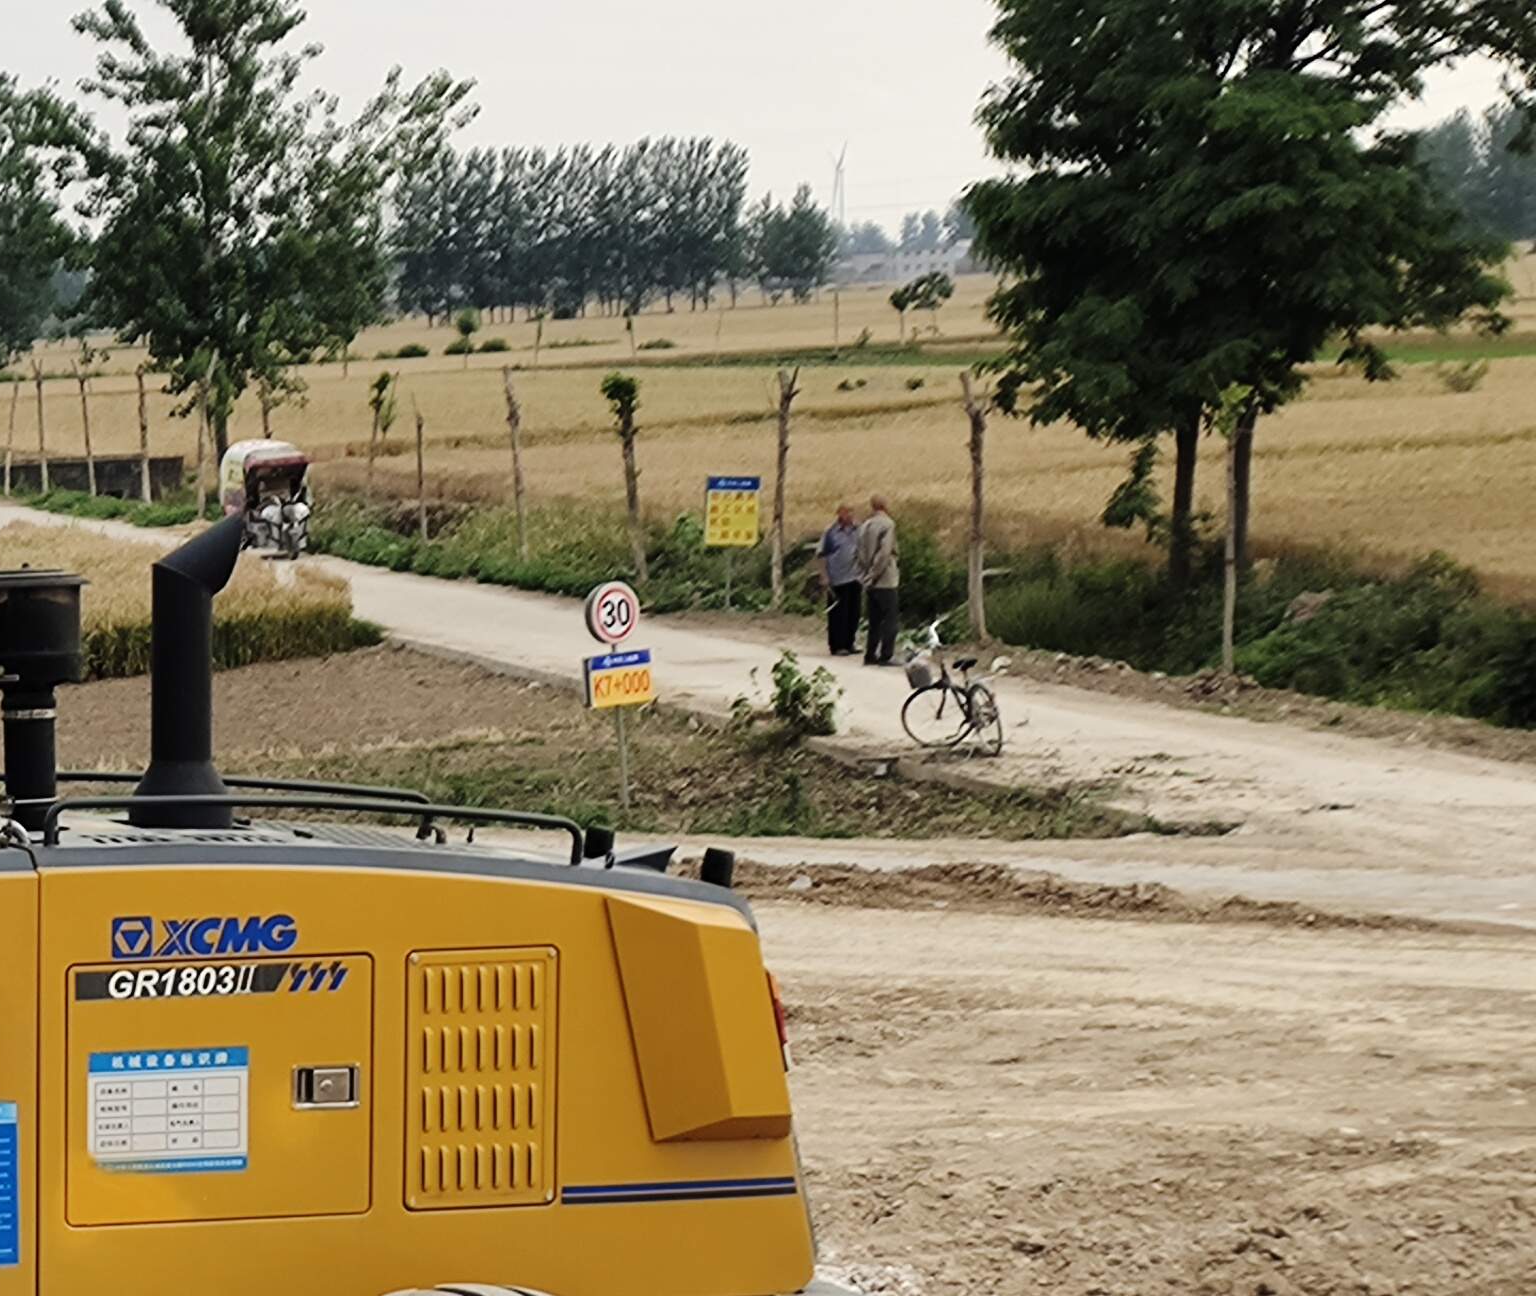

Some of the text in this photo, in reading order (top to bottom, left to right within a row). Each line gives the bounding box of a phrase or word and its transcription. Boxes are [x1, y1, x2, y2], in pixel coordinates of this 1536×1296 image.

[603, 599, 630, 628] 30
[595, 670, 650, 697] K7+000
[153, 915, 297, 956] XCMG
